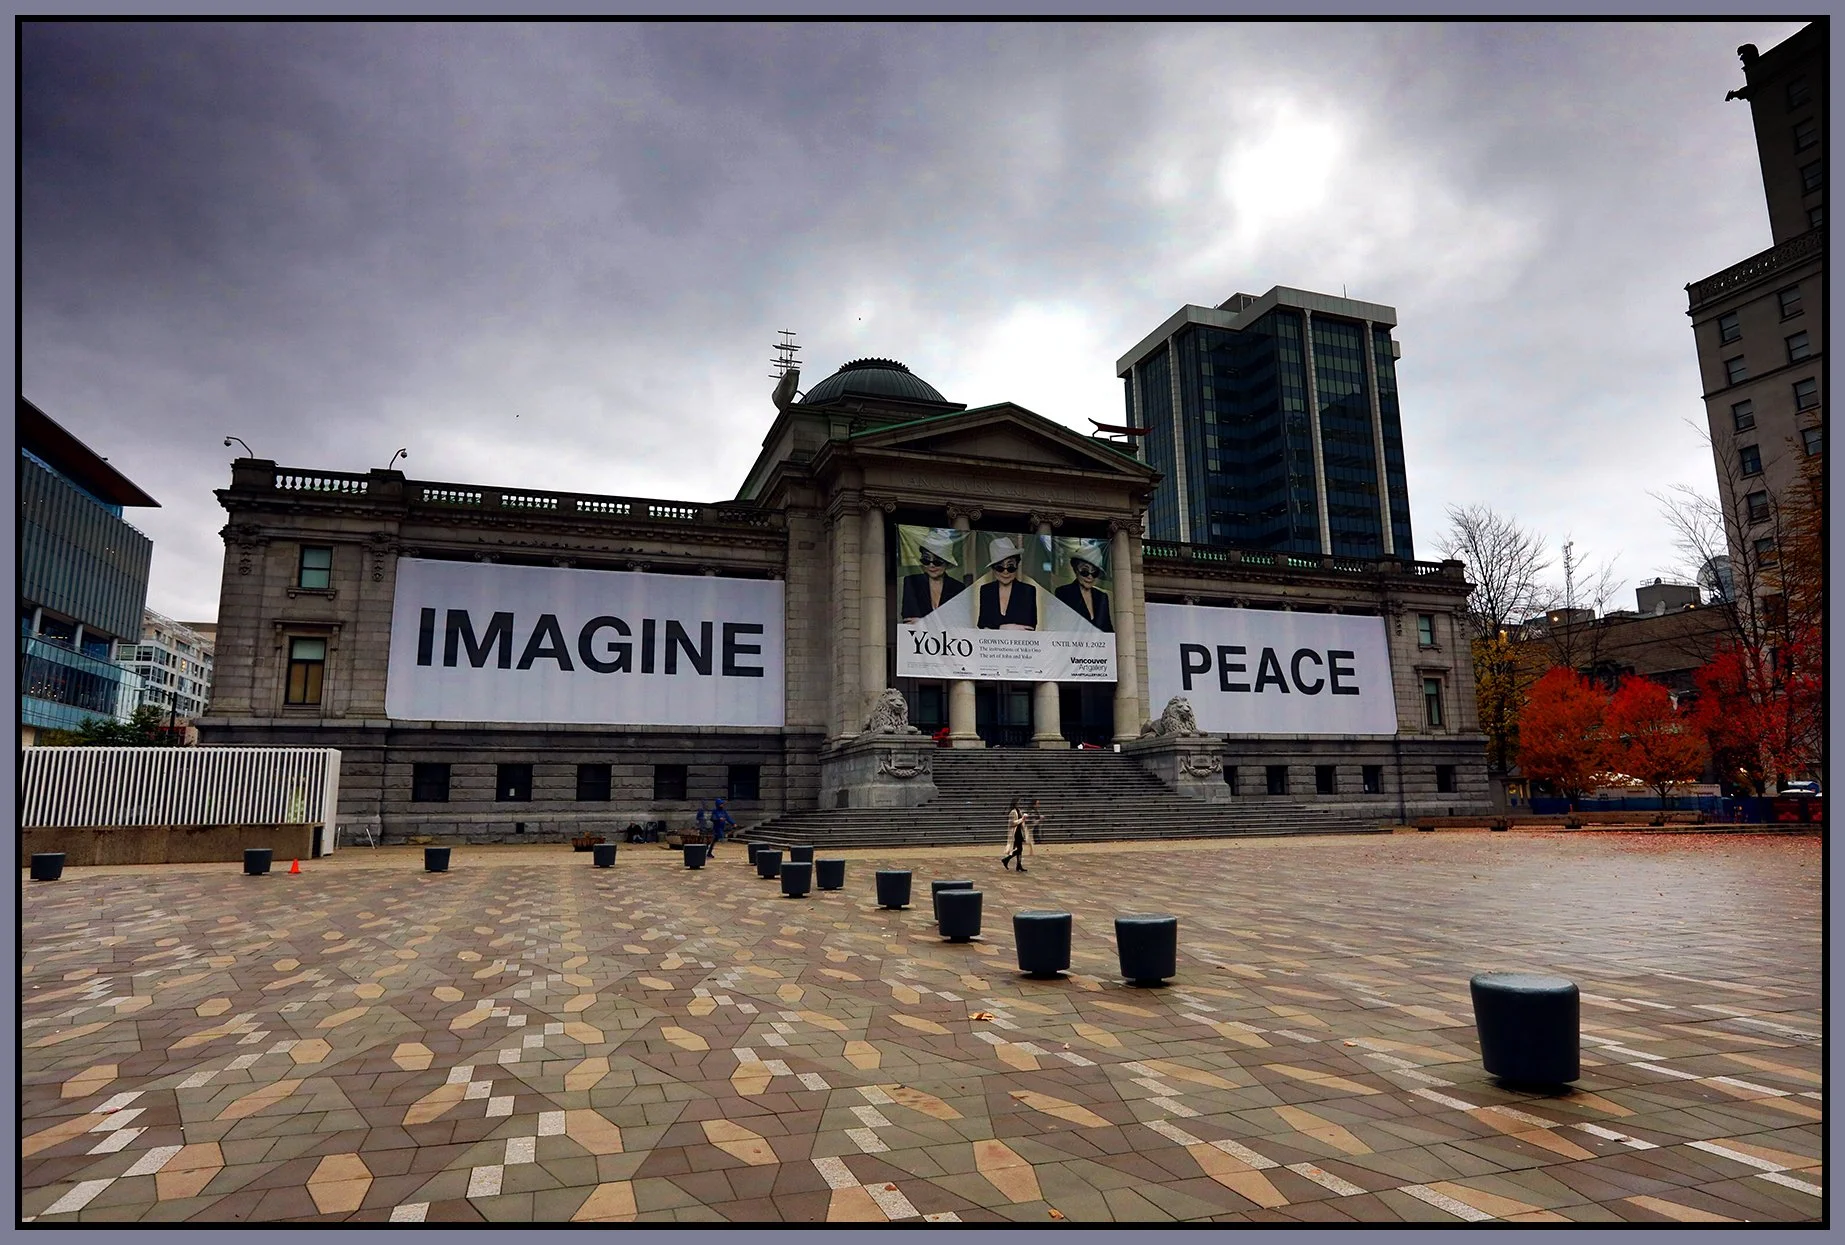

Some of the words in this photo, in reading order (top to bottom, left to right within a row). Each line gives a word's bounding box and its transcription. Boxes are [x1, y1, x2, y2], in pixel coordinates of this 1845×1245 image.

[417, 607, 764, 678] IMAGINE
[908, 630, 973, 657] Yoko
[979, 638, 1009, 646] GROWING
[1079, 664, 1107, 672] Artgallery
[1180, 644, 1359, 696] PEACE
